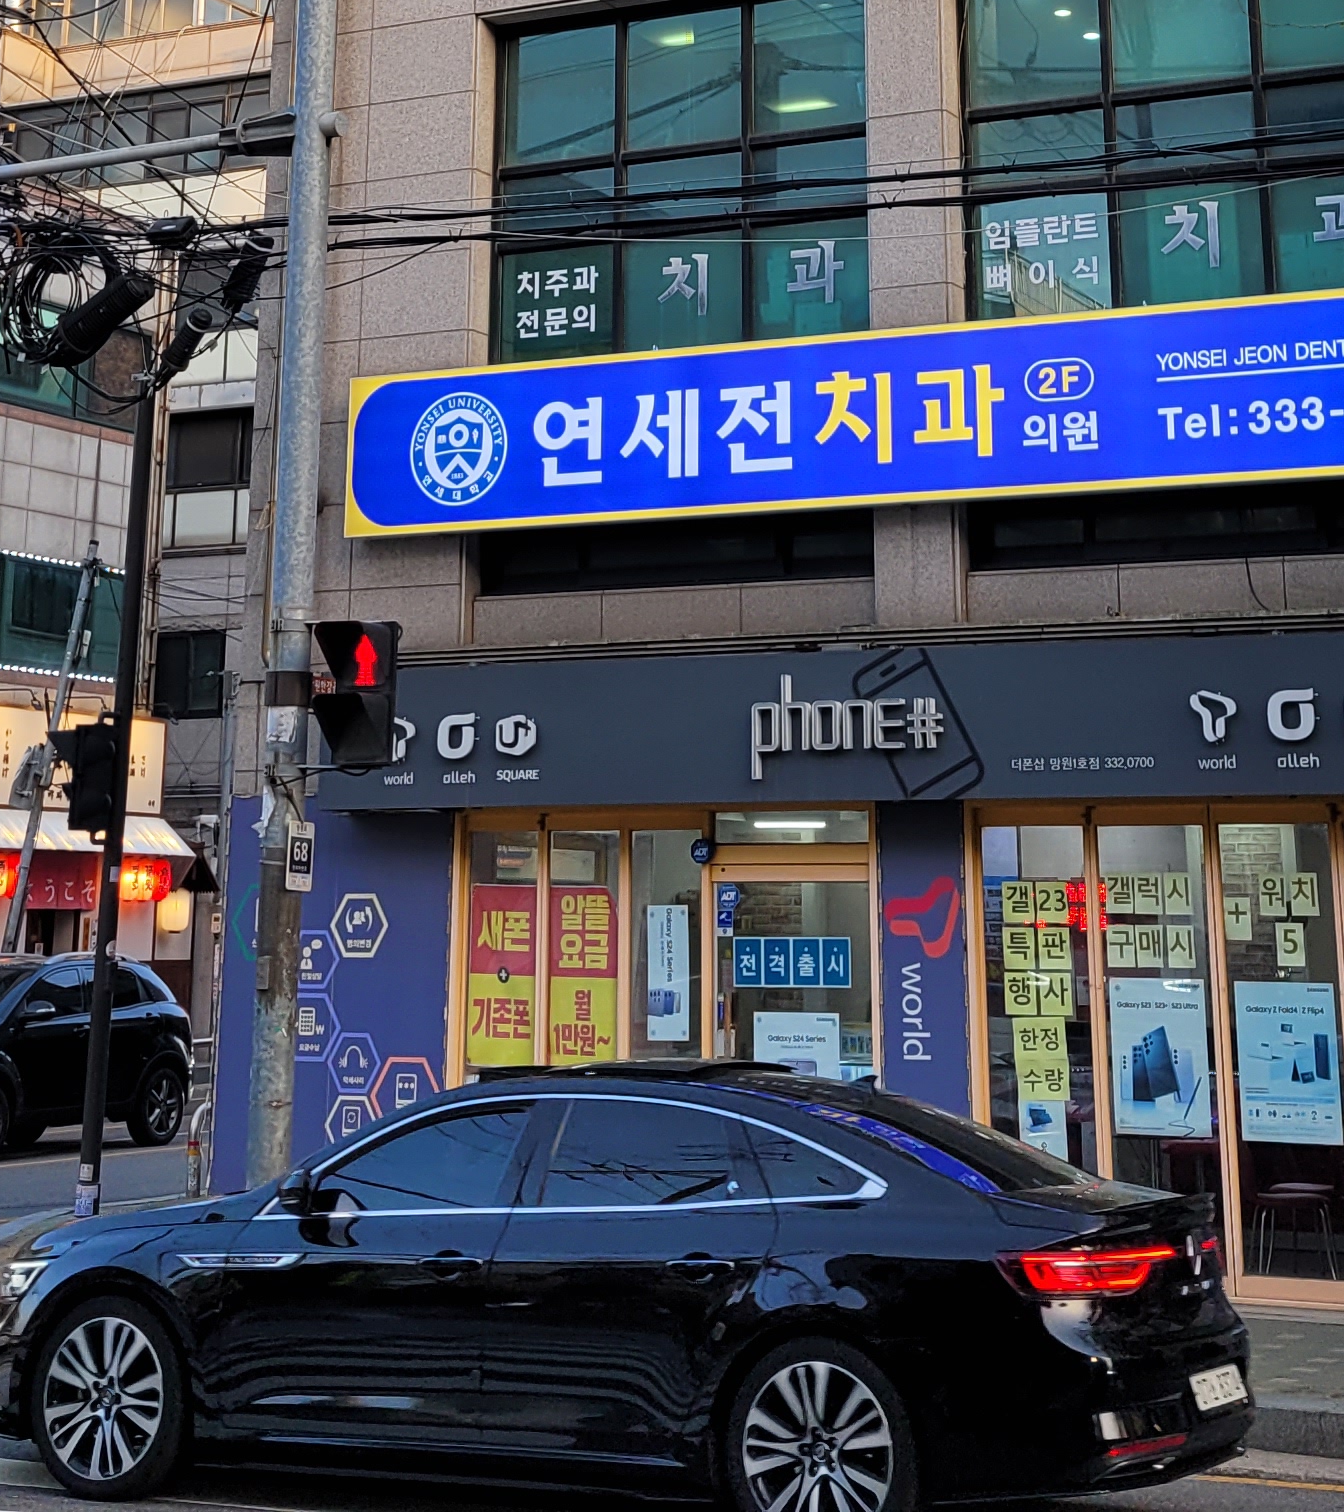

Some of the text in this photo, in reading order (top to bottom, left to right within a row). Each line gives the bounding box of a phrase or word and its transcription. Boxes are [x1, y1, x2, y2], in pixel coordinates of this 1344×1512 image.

[984, 212, 1100, 251] 임플란트
[516, 265, 599, 300] 치주과
[515, 303, 597, 339] 전문의
[1156, 350, 1228, 372] YONSEI
[1233, 342, 1289, 366] JEON
[1037, 366, 1080, 396] 2F
[415, 396, 503, 452] YONSEI UNIVERSITY
[1022, 410, 1100, 453] 의원
[496, 769, 540, 782] SQUARE
[1011, 756, 1045, 771] 더폰샵
[1049, 756, 1100, 771] 망원1호점
[1198, 754, 1237, 769] world
[1277, 752, 1320, 769] olleh
[384, 771, 414, 785] world
[442, 771, 476, 784] olleh
[293, 841, 309, 862] 68
[721, 891, 737, 902] ADT
[1108, 875, 1190, 907] 갤럭시
[1261, 876, 1316, 908] 워치
[560, 894, 611, 931] 알뜰
[477, 910, 531, 952] 새폰
[1006, 931, 1066, 960] 특판
[1109, 929, 1193, 960] 구매시
[559, 933, 609, 970] 요금
[574, 989, 592, 1022] 월
[1008, 976, 1068, 1007] 행사
[471, 997, 532, 1039] 기존폰
[898, 962, 933, 1062] world
[767, 1035, 792, 1043] Galaxy
[1019, 1026, 1060, 1052] 한정
[1023, 1068, 1065, 1093] 수량
